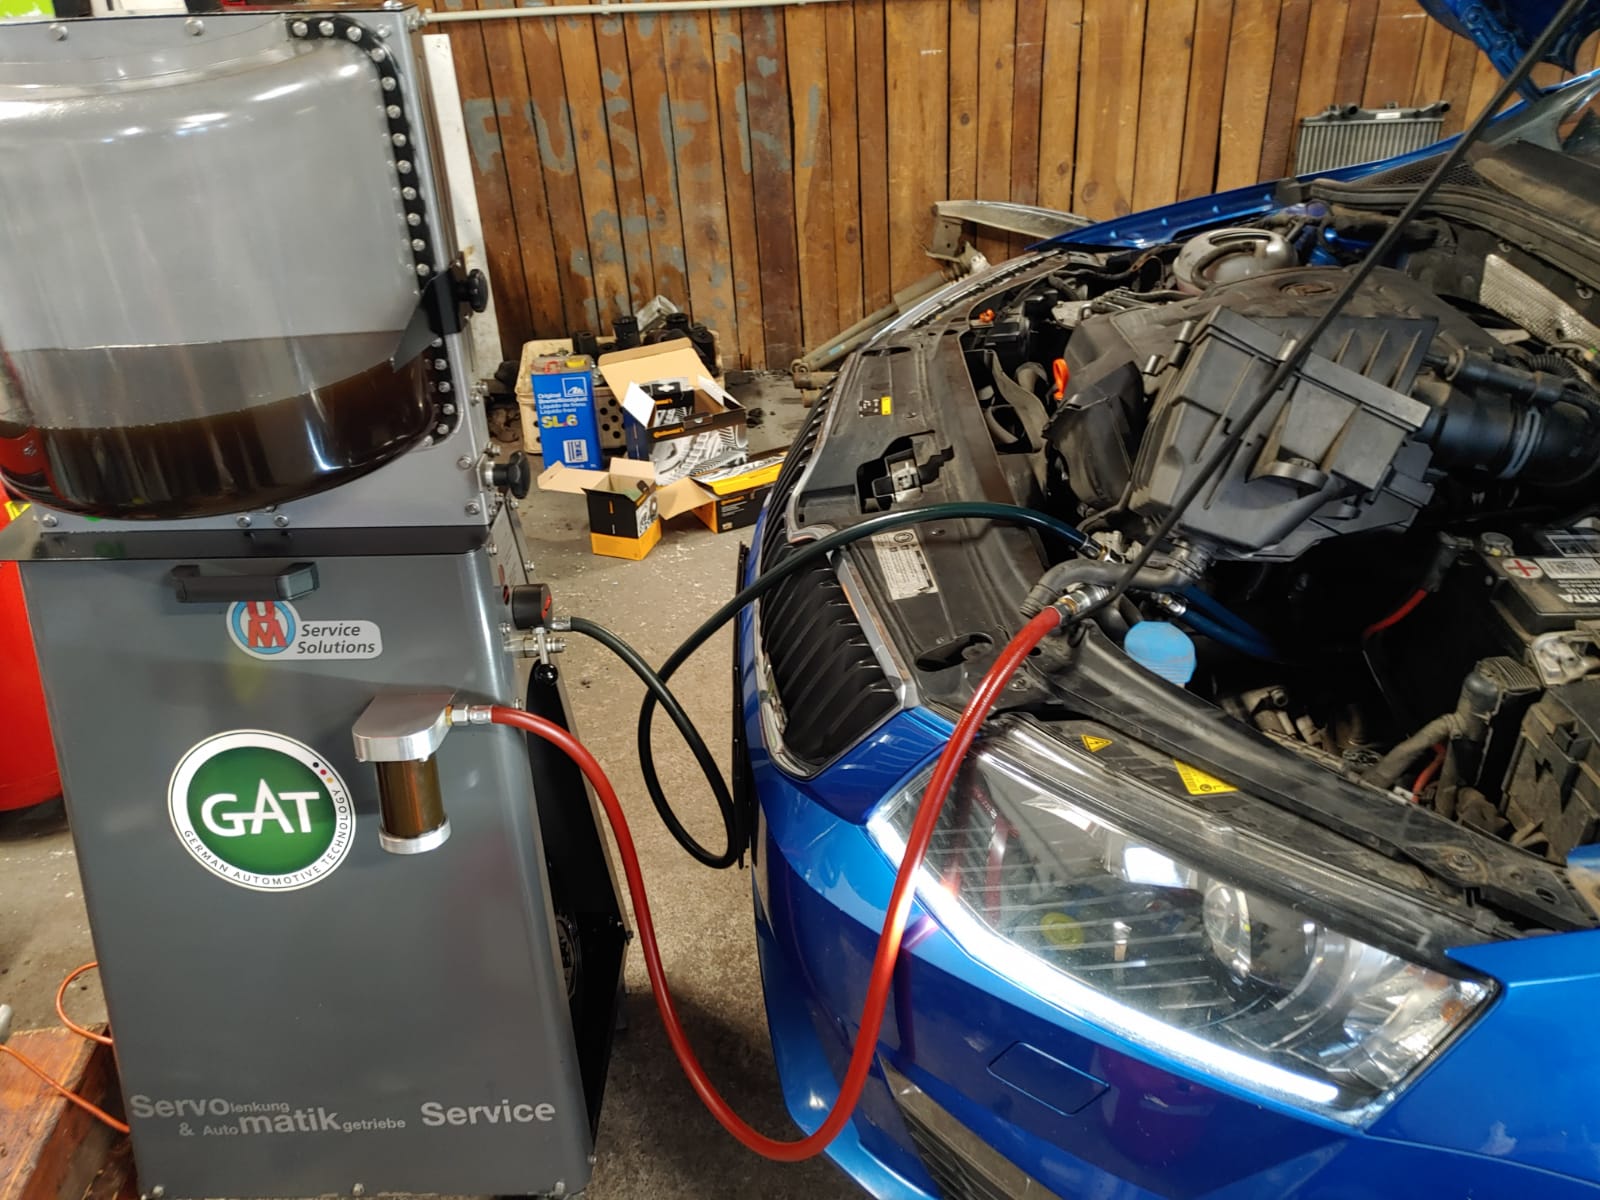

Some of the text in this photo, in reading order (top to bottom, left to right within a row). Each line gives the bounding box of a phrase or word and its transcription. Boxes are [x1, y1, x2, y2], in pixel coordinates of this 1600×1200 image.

[297, 640, 376, 655] Solutions
[301, 623, 361, 637] Service
[201, 778, 320, 837] GAT
[184, 789, 349, 885] GERMAN AUTOMOTIVE TECHNOLOGY
[178, 1122, 195, 1136] &
[420, 1099, 556, 1126] Service
